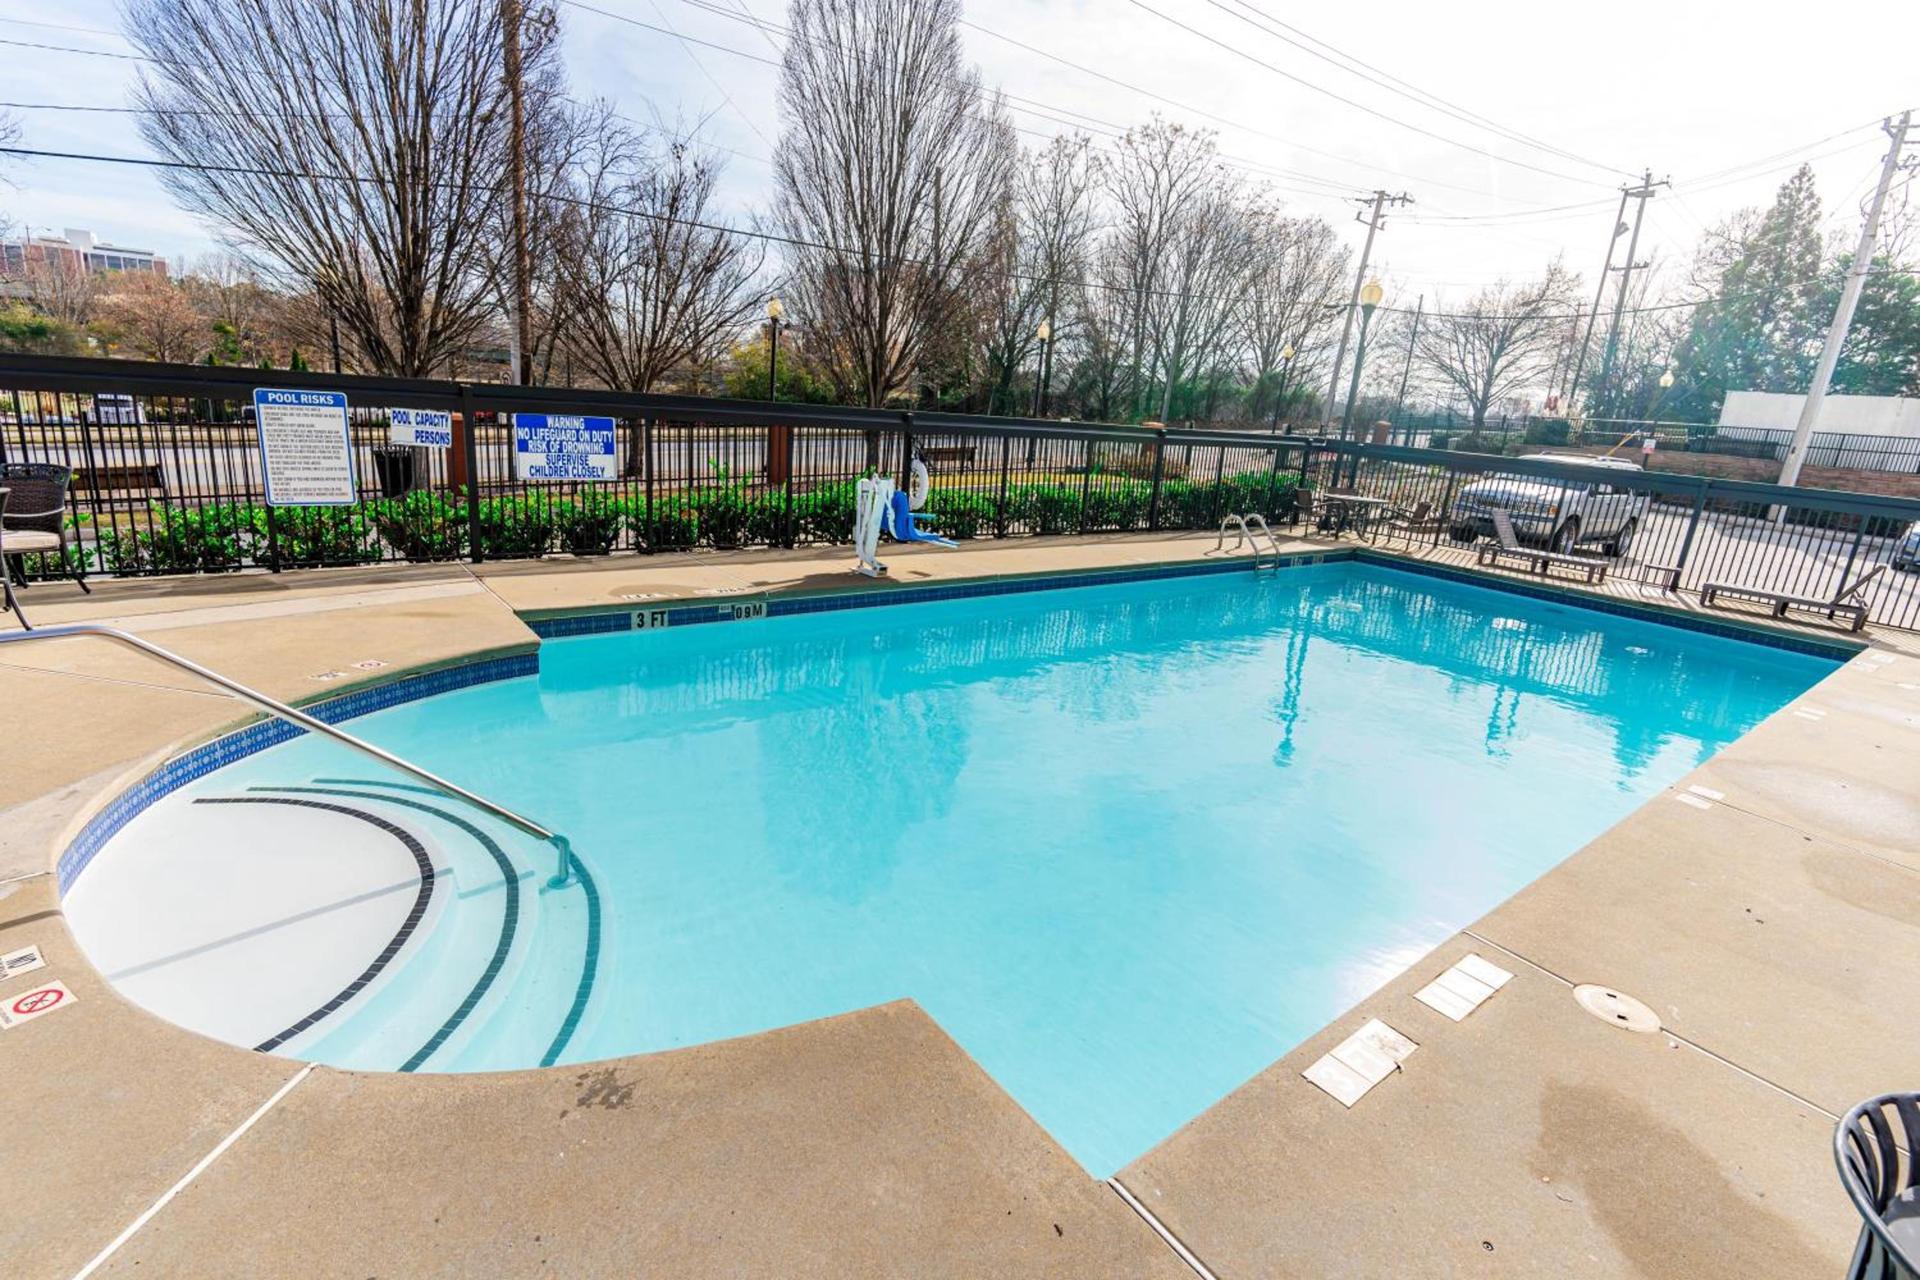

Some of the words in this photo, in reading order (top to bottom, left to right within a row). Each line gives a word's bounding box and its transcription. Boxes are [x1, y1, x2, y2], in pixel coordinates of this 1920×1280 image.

[268, 393, 298, 403] POOL
[300, 394, 334, 405] RISKS
[392, 410, 411, 425] POOL
[415, 411, 449, 428] CAPACITY
[547, 416, 585, 429] WARNING
[415, 429, 450, 445] PERSONS
[517, 427, 530, 440] NO
[532, 428, 577, 441] LIFEGUARD
[578, 430, 591, 442] ON
[592, 431, 612, 443] DUTY
[528, 440, 548, 453] RISK
[549, 441, 560, 453] OF
[562, 441, 604, 454] DROWNING
[546, 454, 590, 466] SUPERVISE
[529, 465, 569, 477] CHILDREN
[572, 466, 605, 478] CLOSELY
[637, 612, 645, 628] 3
[651, 611, 666, 627] FT
